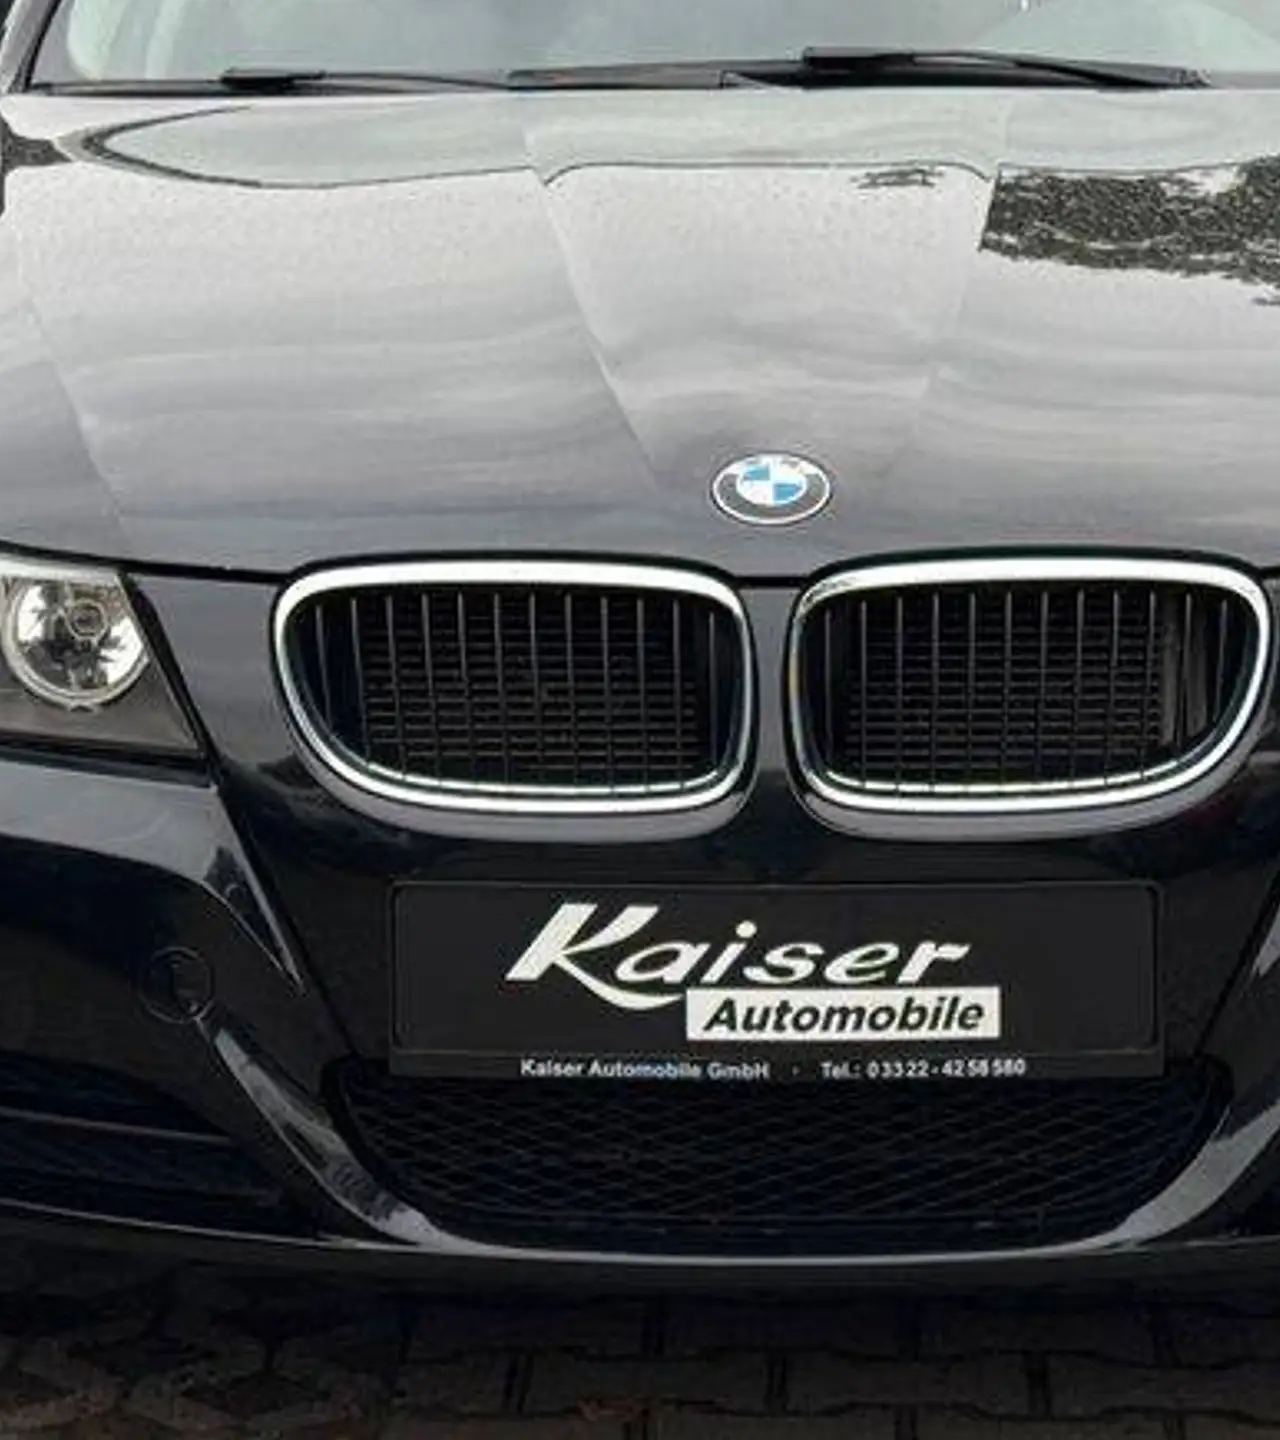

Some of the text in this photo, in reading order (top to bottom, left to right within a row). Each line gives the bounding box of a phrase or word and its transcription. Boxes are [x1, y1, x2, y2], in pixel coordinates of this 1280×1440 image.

[505, 902, 971, 1011] Kaiser
[703, 997, 985, 1035] Automobile
[520, 1058, 583, 1079] Kaiser
[587, 1059, 702, 1079] Automobile
[707, 1061, 770, 1080] GmbH
